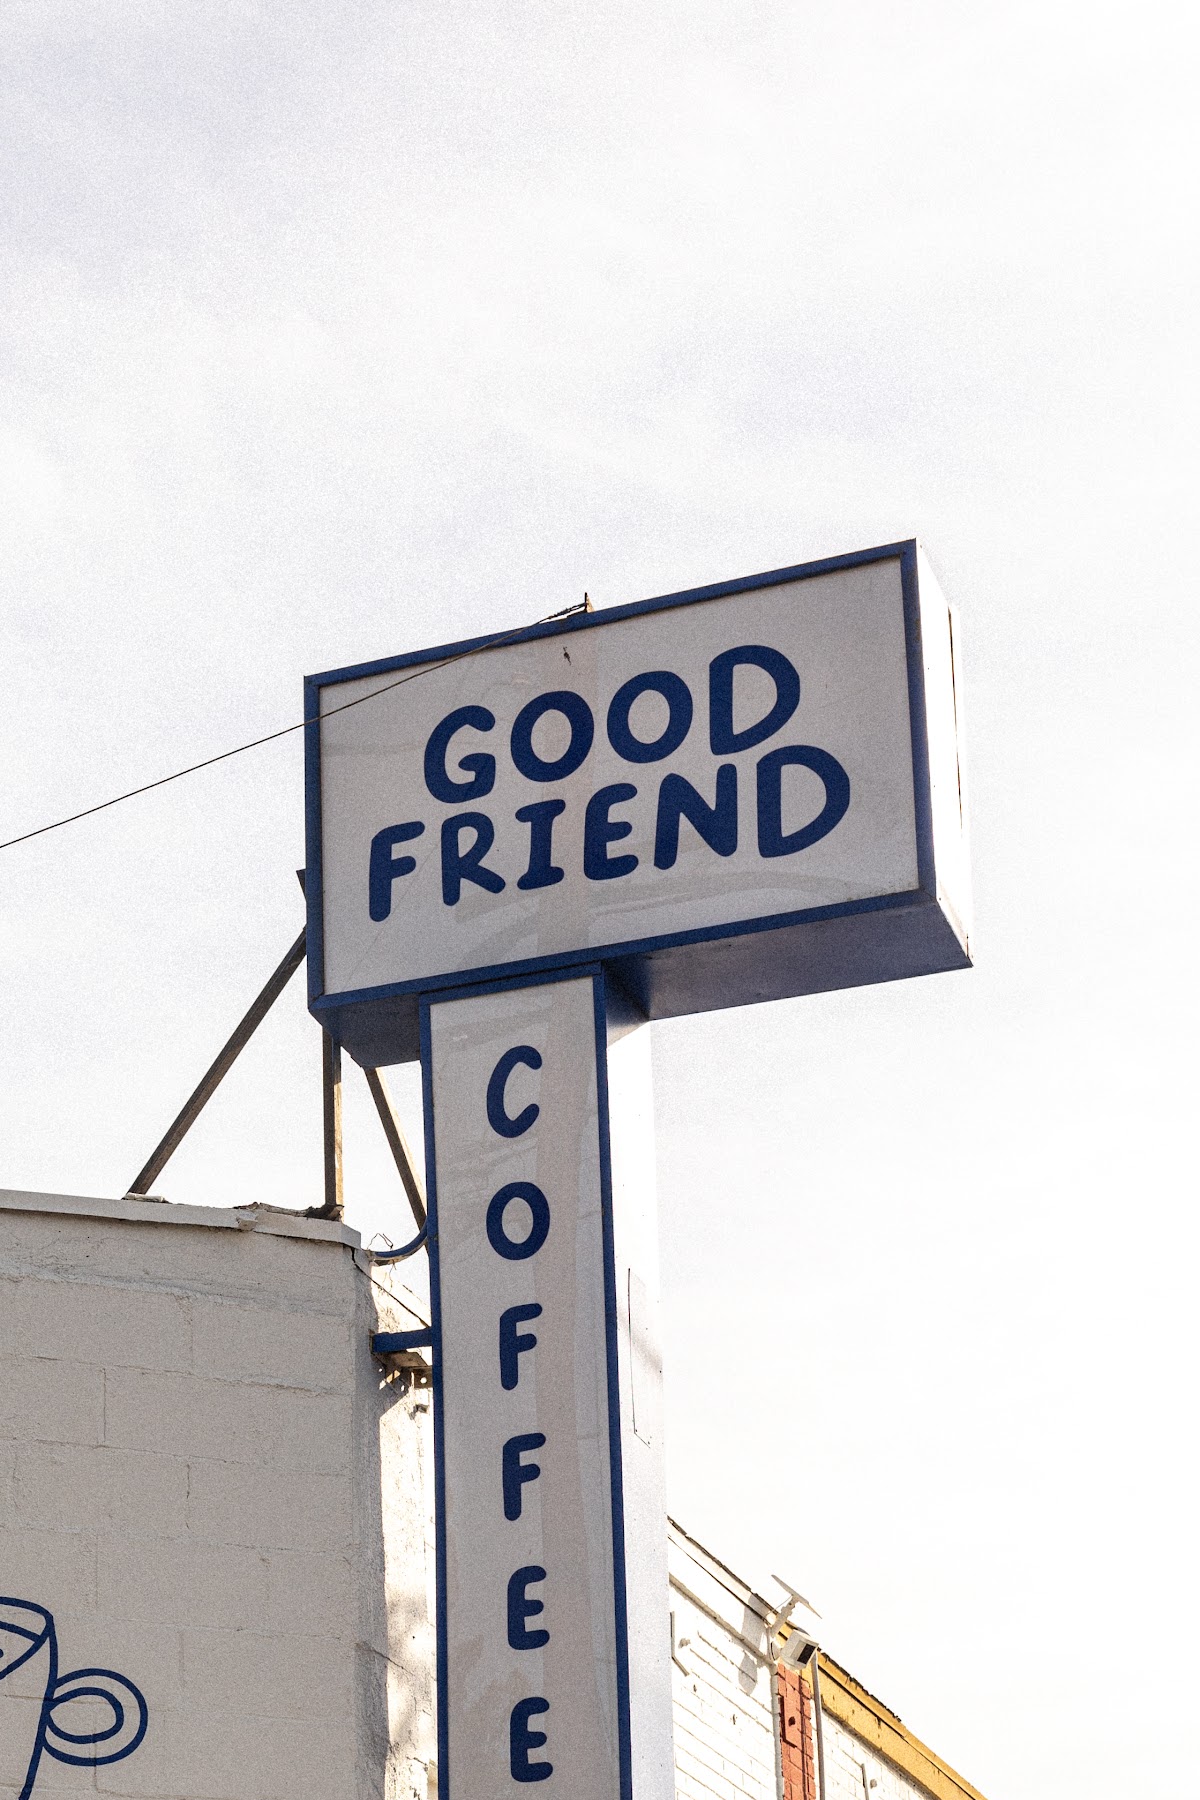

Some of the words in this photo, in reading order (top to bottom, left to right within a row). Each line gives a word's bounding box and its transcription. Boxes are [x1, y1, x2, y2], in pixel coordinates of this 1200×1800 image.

[425, 646, 800, 804] GOOD
[370, 746, 851, 922] FRIEND
[487, 1047, 551, 1782] COFFEE
